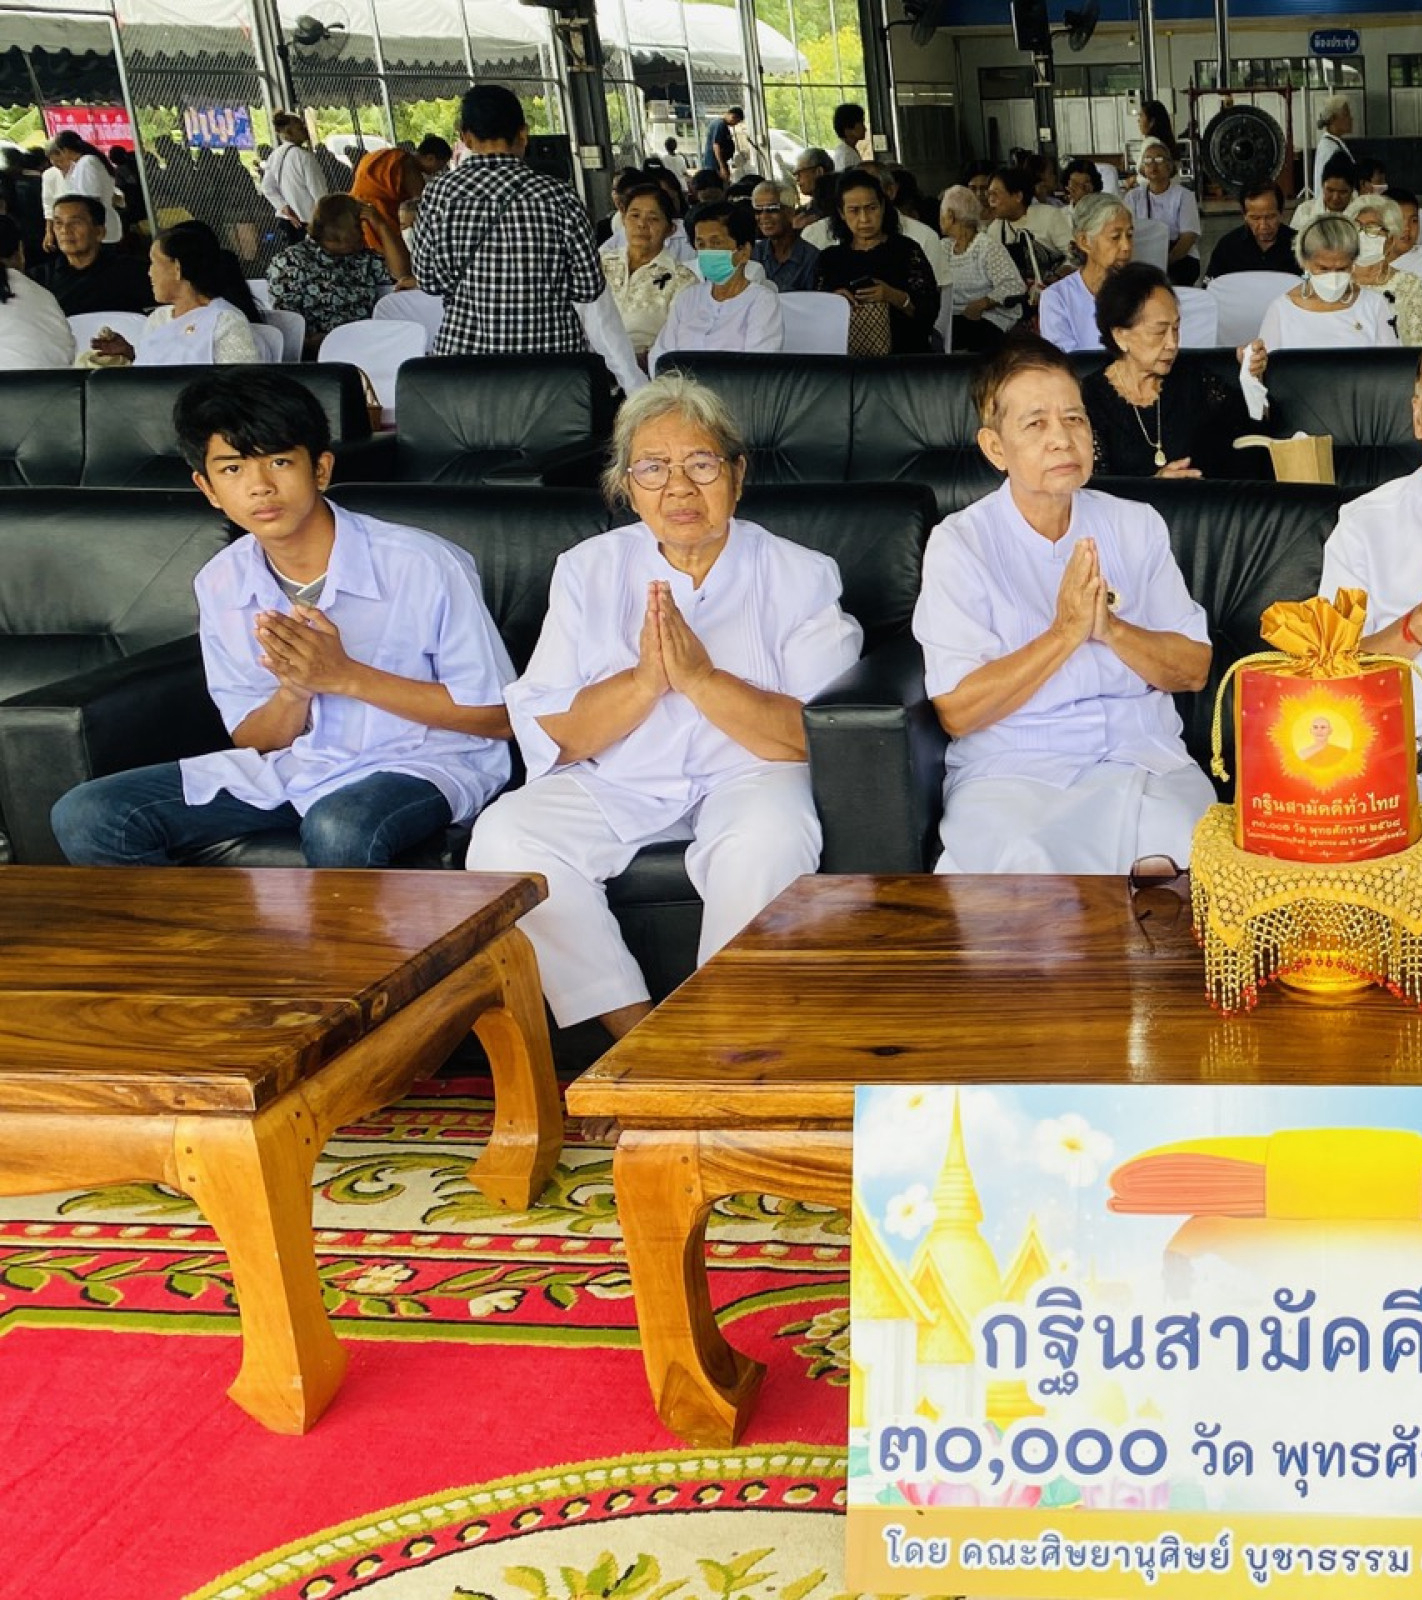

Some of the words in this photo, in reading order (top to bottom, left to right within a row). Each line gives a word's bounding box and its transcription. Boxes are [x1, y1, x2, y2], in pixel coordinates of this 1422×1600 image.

[1252, 793, 1400, 816] กฐินสามัคคีทั่วไทย
[880, 1426, 1168, 1485] ๓๐,๐๐๐
[1192, 1422, 1253, 1476] วัด
[886, 1529, 947, 1564] โดย
[964, 1534, 1229, 1581] คณะศิษยานุศิษย์
[1247, 1547, 1409, 1583] บูชาธรรม
